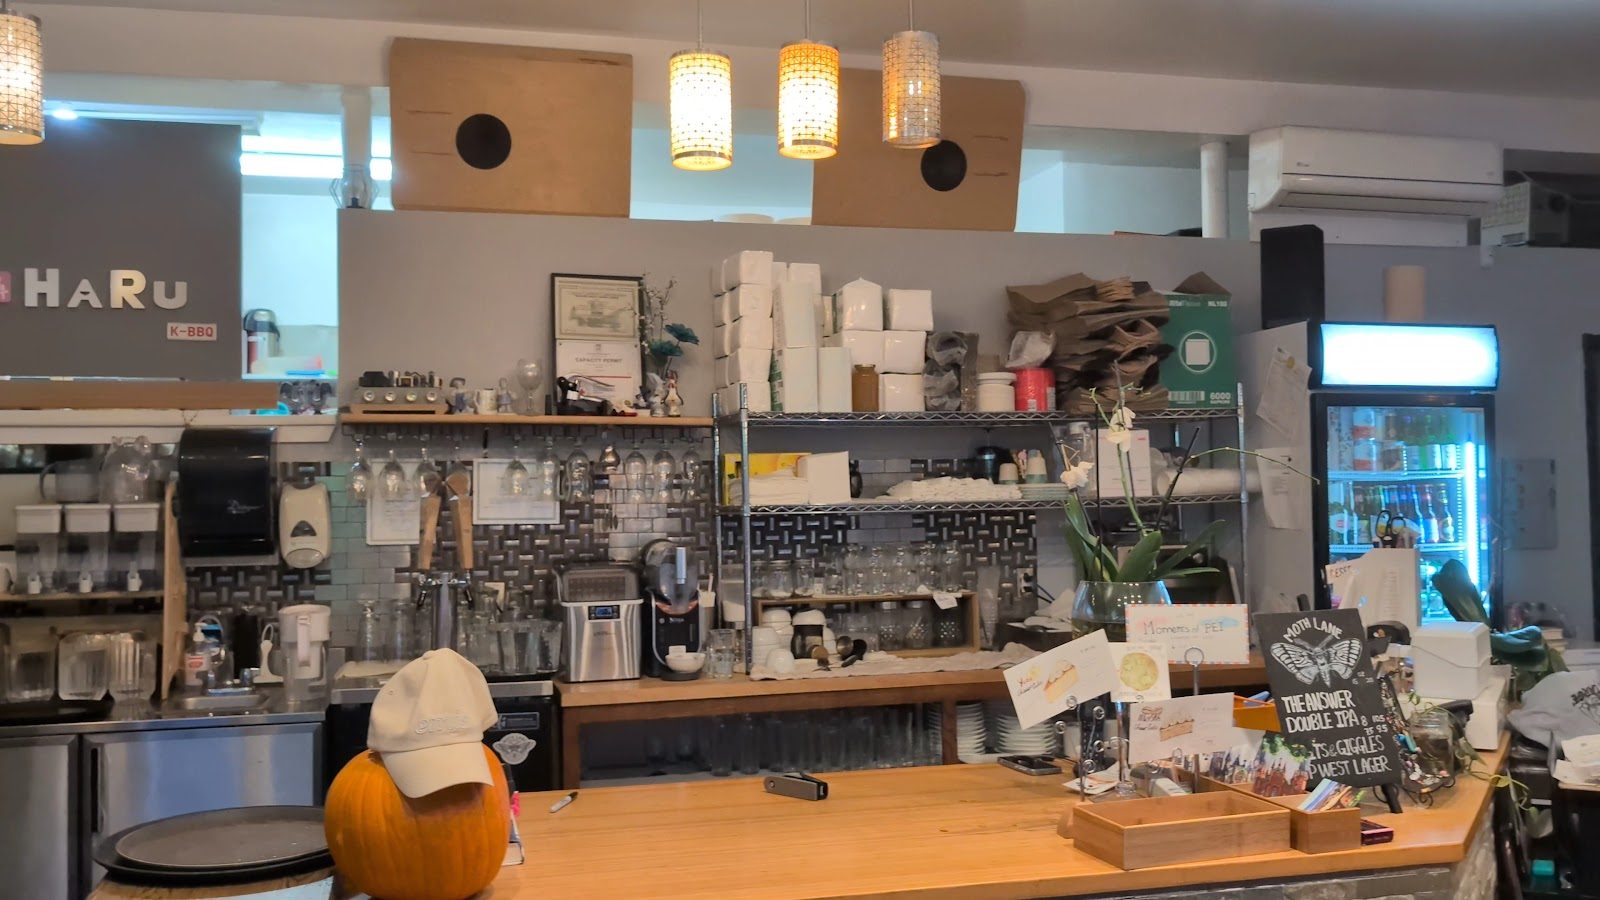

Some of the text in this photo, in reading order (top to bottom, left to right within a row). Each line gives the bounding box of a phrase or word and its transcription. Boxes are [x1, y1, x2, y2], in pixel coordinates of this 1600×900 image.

[24, 267, 188, 310] HARU
[169, 326, 214, 338] K-BBQ
[1210, 392, 1231, 400] 6000
[1204, 621, 1224, 634] PEI
[1282, 617, 1343, 643] MOTH LANE
[1281, 689, 1357, 714] THE ANSWER
[1285, 712, 1334, 734] DOUBLE
[1333, 708, 1360, 728] IPA
[1360, 715, 1369, 727] 8
[1316, 759, 1351, 778] WEST
[1352, 755, 1393, 775] LAGER
